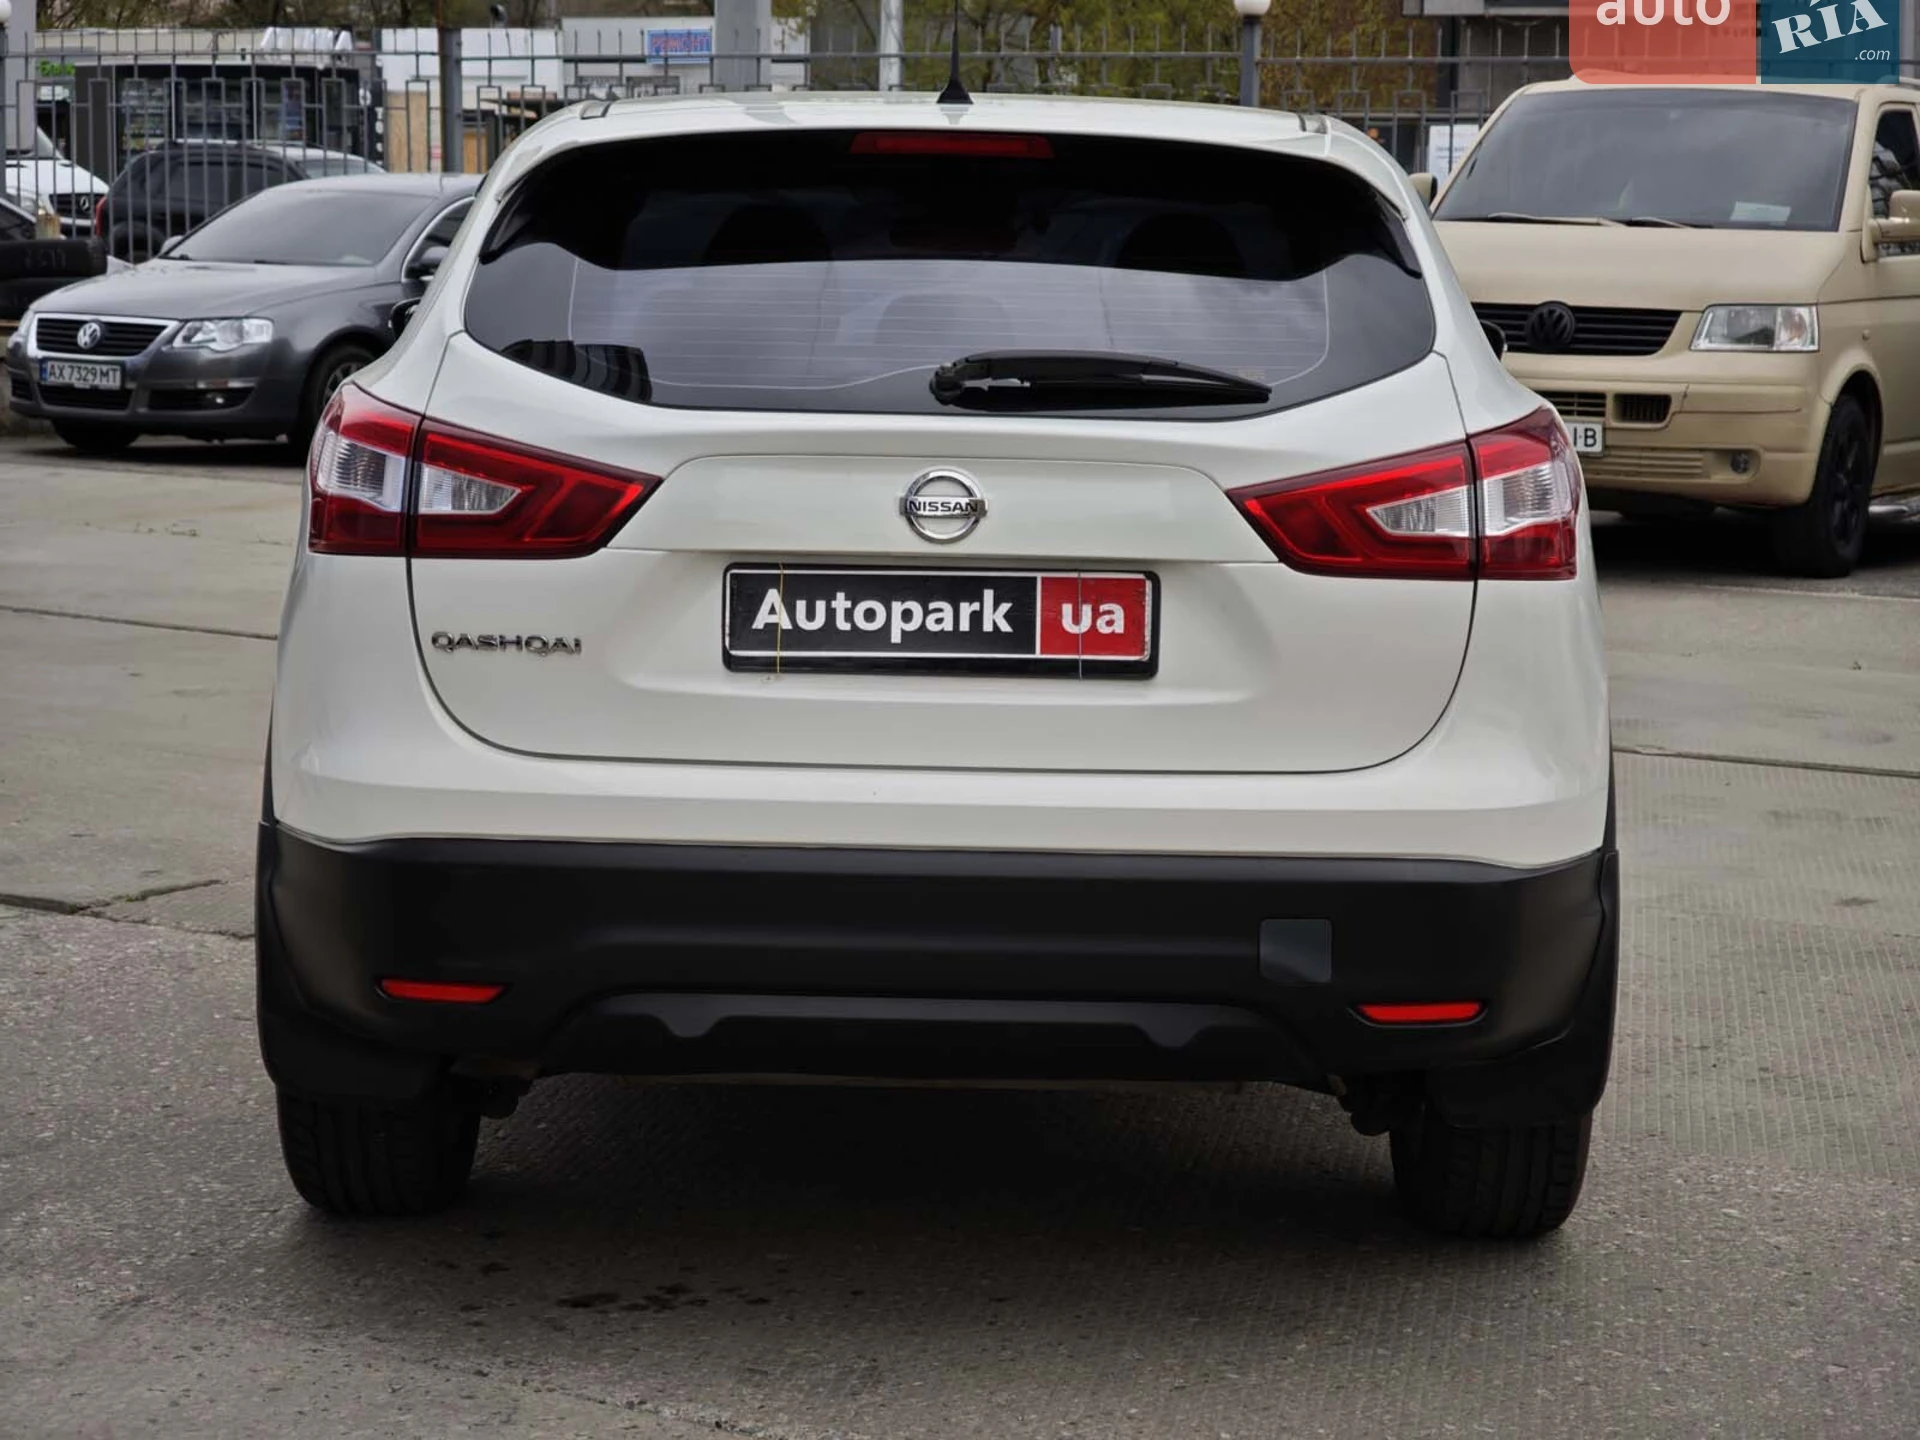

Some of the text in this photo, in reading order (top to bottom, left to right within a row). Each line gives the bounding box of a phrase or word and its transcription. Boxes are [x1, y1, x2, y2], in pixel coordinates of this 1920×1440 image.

[909, 501, 978, 513] NISSAN
[752, 588, 1125, 644] Autopark ua
[431, 631, 582, 657] QASHQAI
